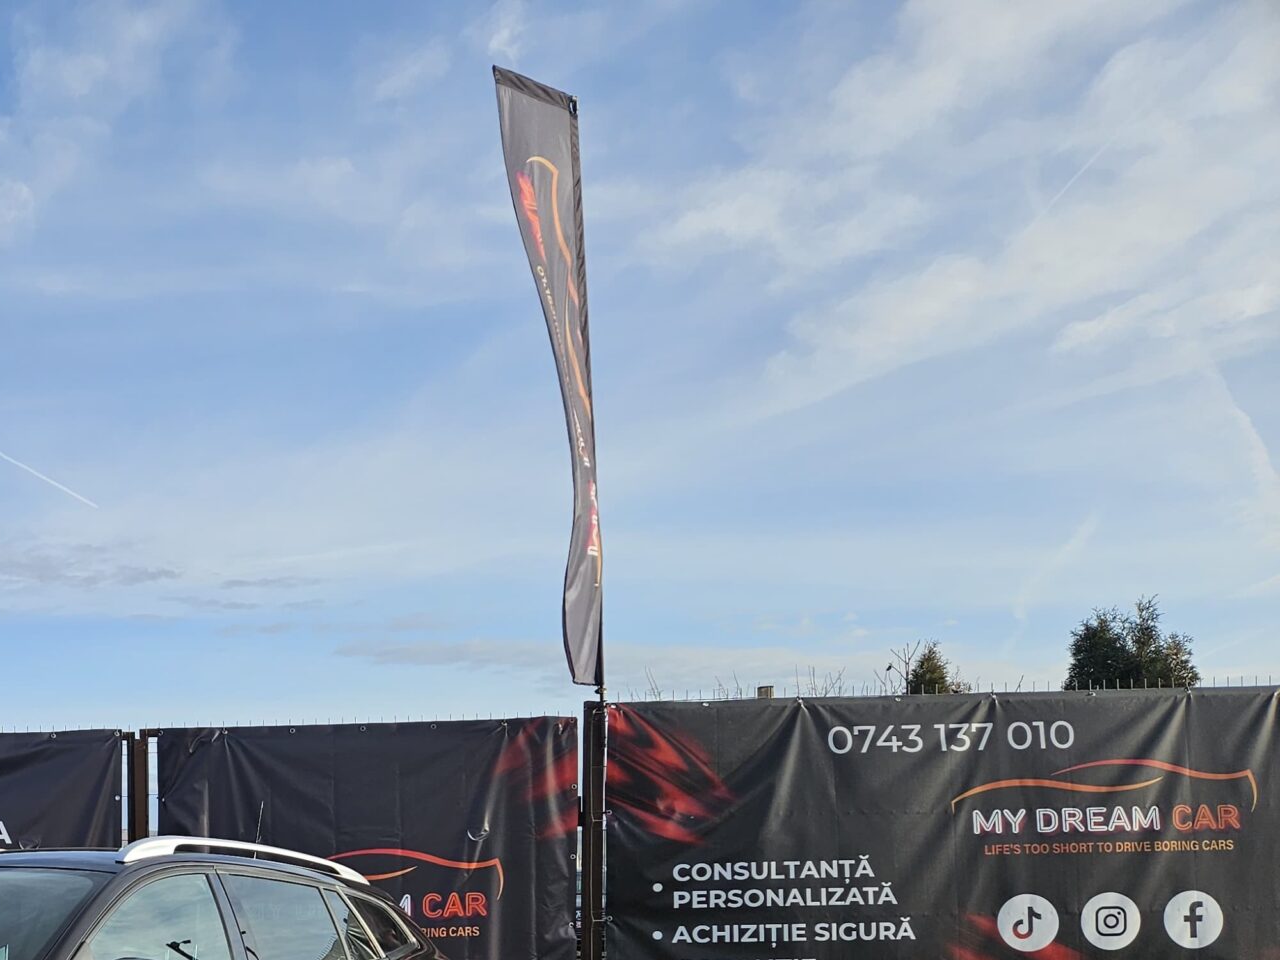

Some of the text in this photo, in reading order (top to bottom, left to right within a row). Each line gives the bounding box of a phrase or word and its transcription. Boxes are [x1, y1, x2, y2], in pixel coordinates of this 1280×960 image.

[827, 720, 1075, 754] 0743 137 010
[972, 804, 1241, 835] MY DREAM CAR
[984, 839, 1234, 855] LIFE'S TOO SHORT TO DRIVE BORING CARS
[672, 855, 875, 884] CONSULTANȚĂ
[422, 892, 488, 918] CAR
[673, 882, 898, 909] PERSONALIZATĂ
[449, 926, 480, 937] CARS
[672, 917, 916, 948] ACHIZIȚIE SIGURĂ
